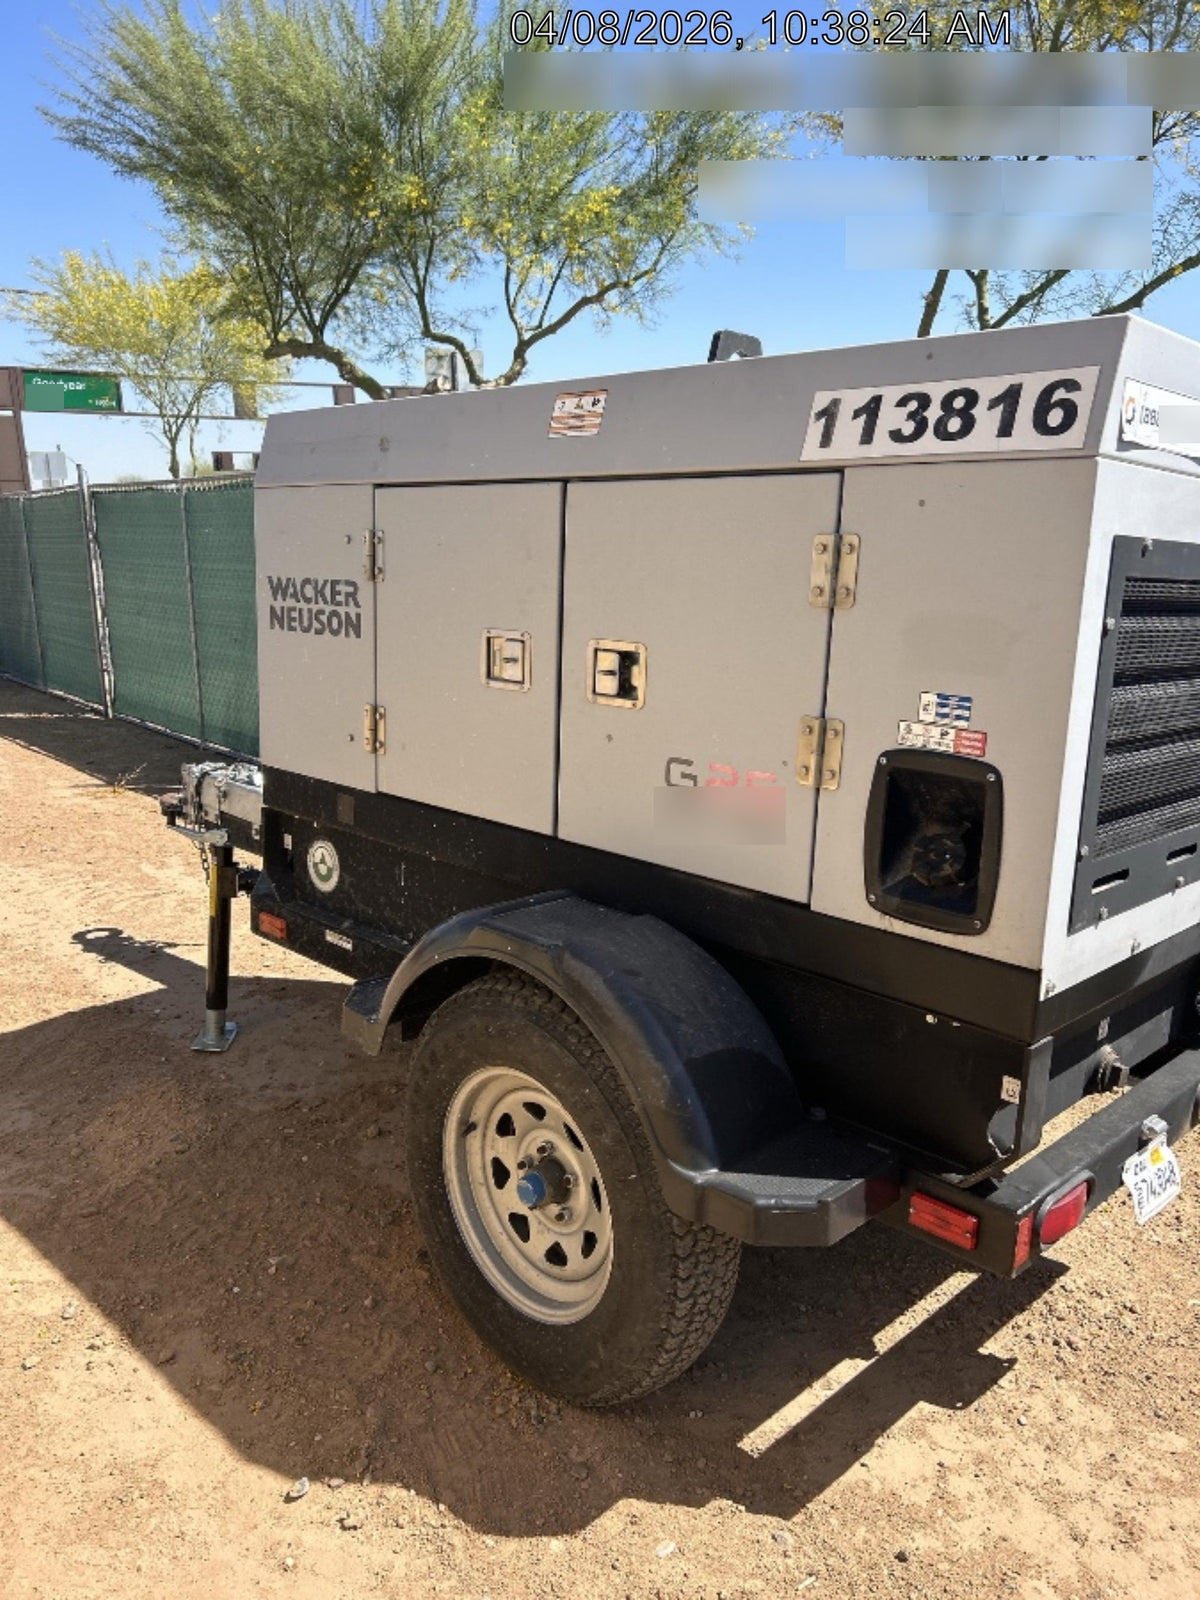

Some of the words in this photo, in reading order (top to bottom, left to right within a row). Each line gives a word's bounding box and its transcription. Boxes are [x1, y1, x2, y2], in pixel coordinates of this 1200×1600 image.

[813, 378, 1083, 449] 113816
[266, 575, 362, 608] WACKER
[269, 604, 362, 639] NEUSON
